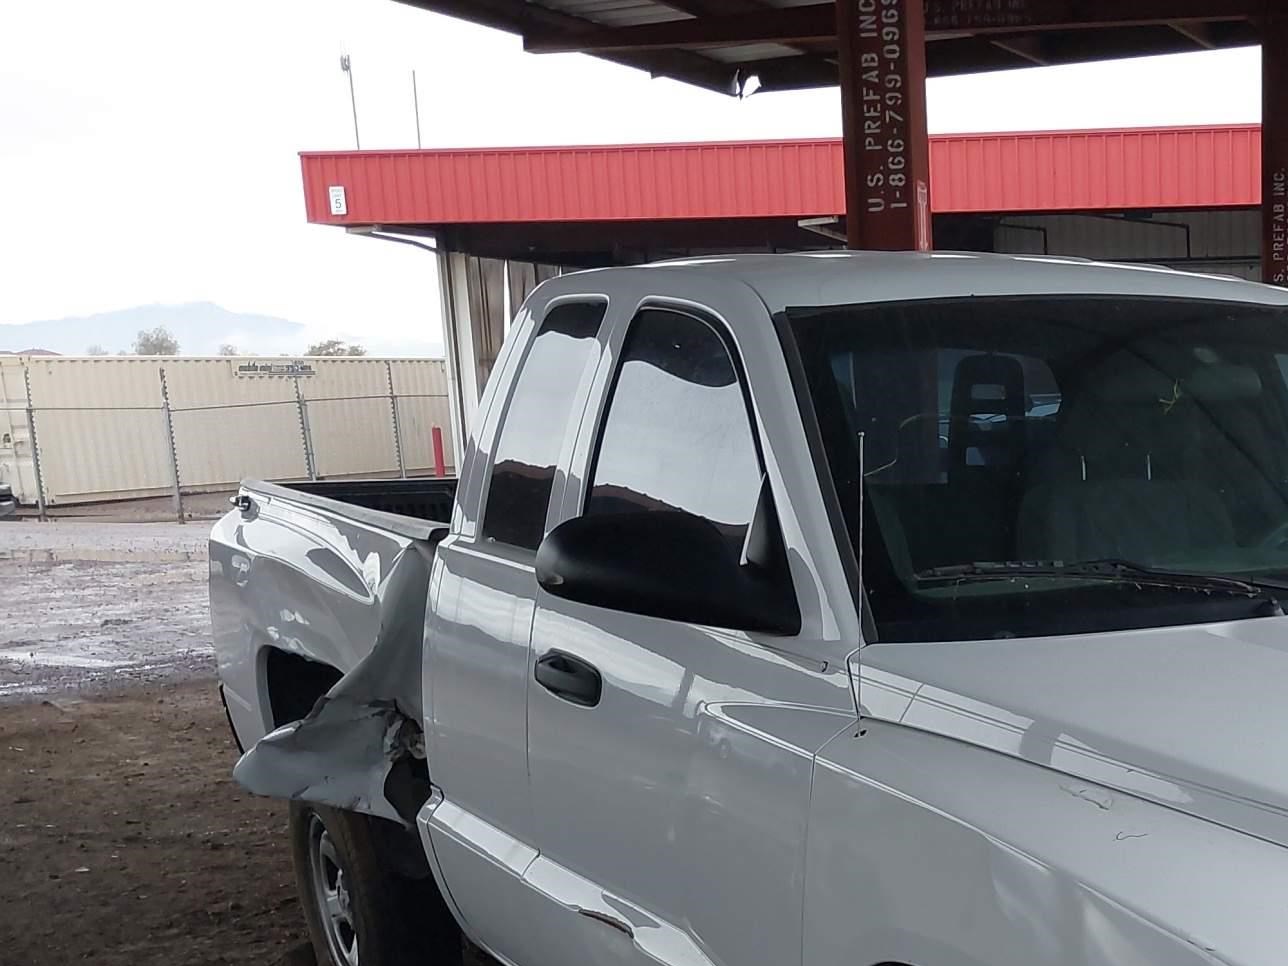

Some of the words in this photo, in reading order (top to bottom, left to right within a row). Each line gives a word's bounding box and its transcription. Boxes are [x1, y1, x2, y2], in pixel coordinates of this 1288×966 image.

[862, 53, 882, 150] PREFAB
[867, 165, 885, 212] U.S.
[1273, 204, 1284, 261] PREFAB
